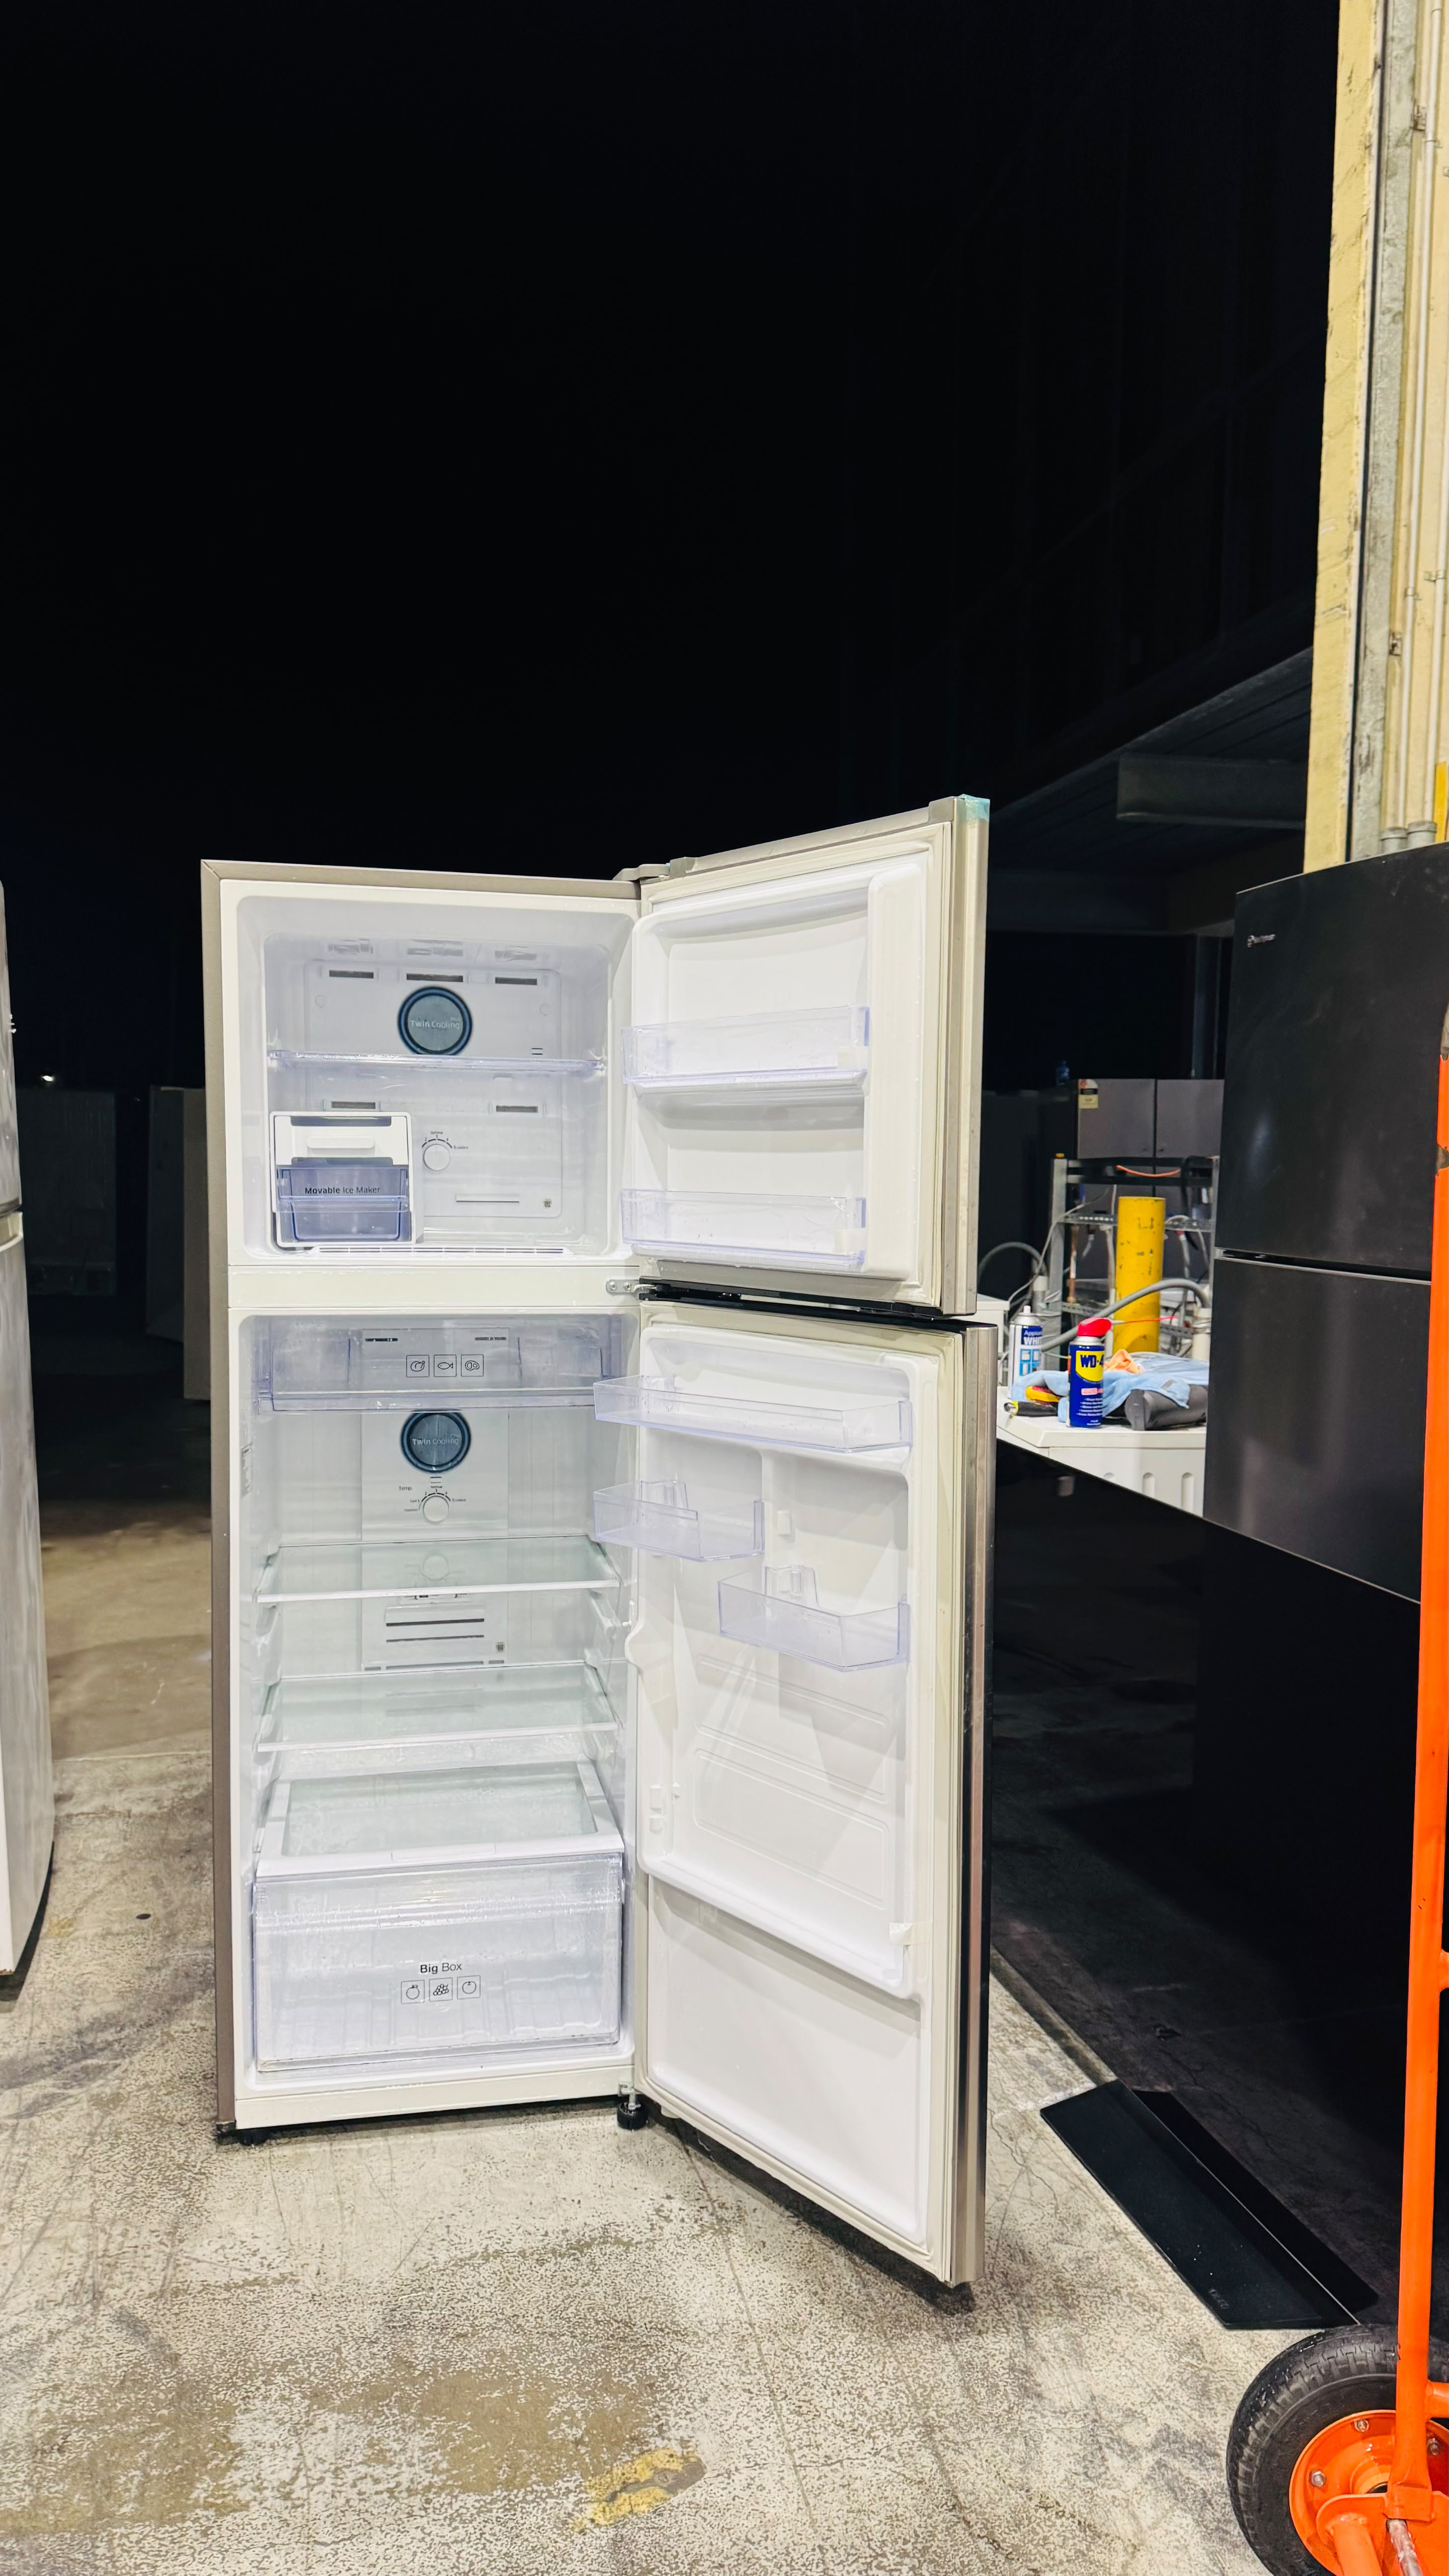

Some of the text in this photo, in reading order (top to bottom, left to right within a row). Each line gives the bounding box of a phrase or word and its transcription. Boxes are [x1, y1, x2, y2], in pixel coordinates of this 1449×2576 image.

[411, 1019, 460, 1030] Twin Cooling
[304, 1186, 340, 1194] Movable
[356, 1186, 381, 1194] Maker
[420, 1962, 462, 1975] Big Box
